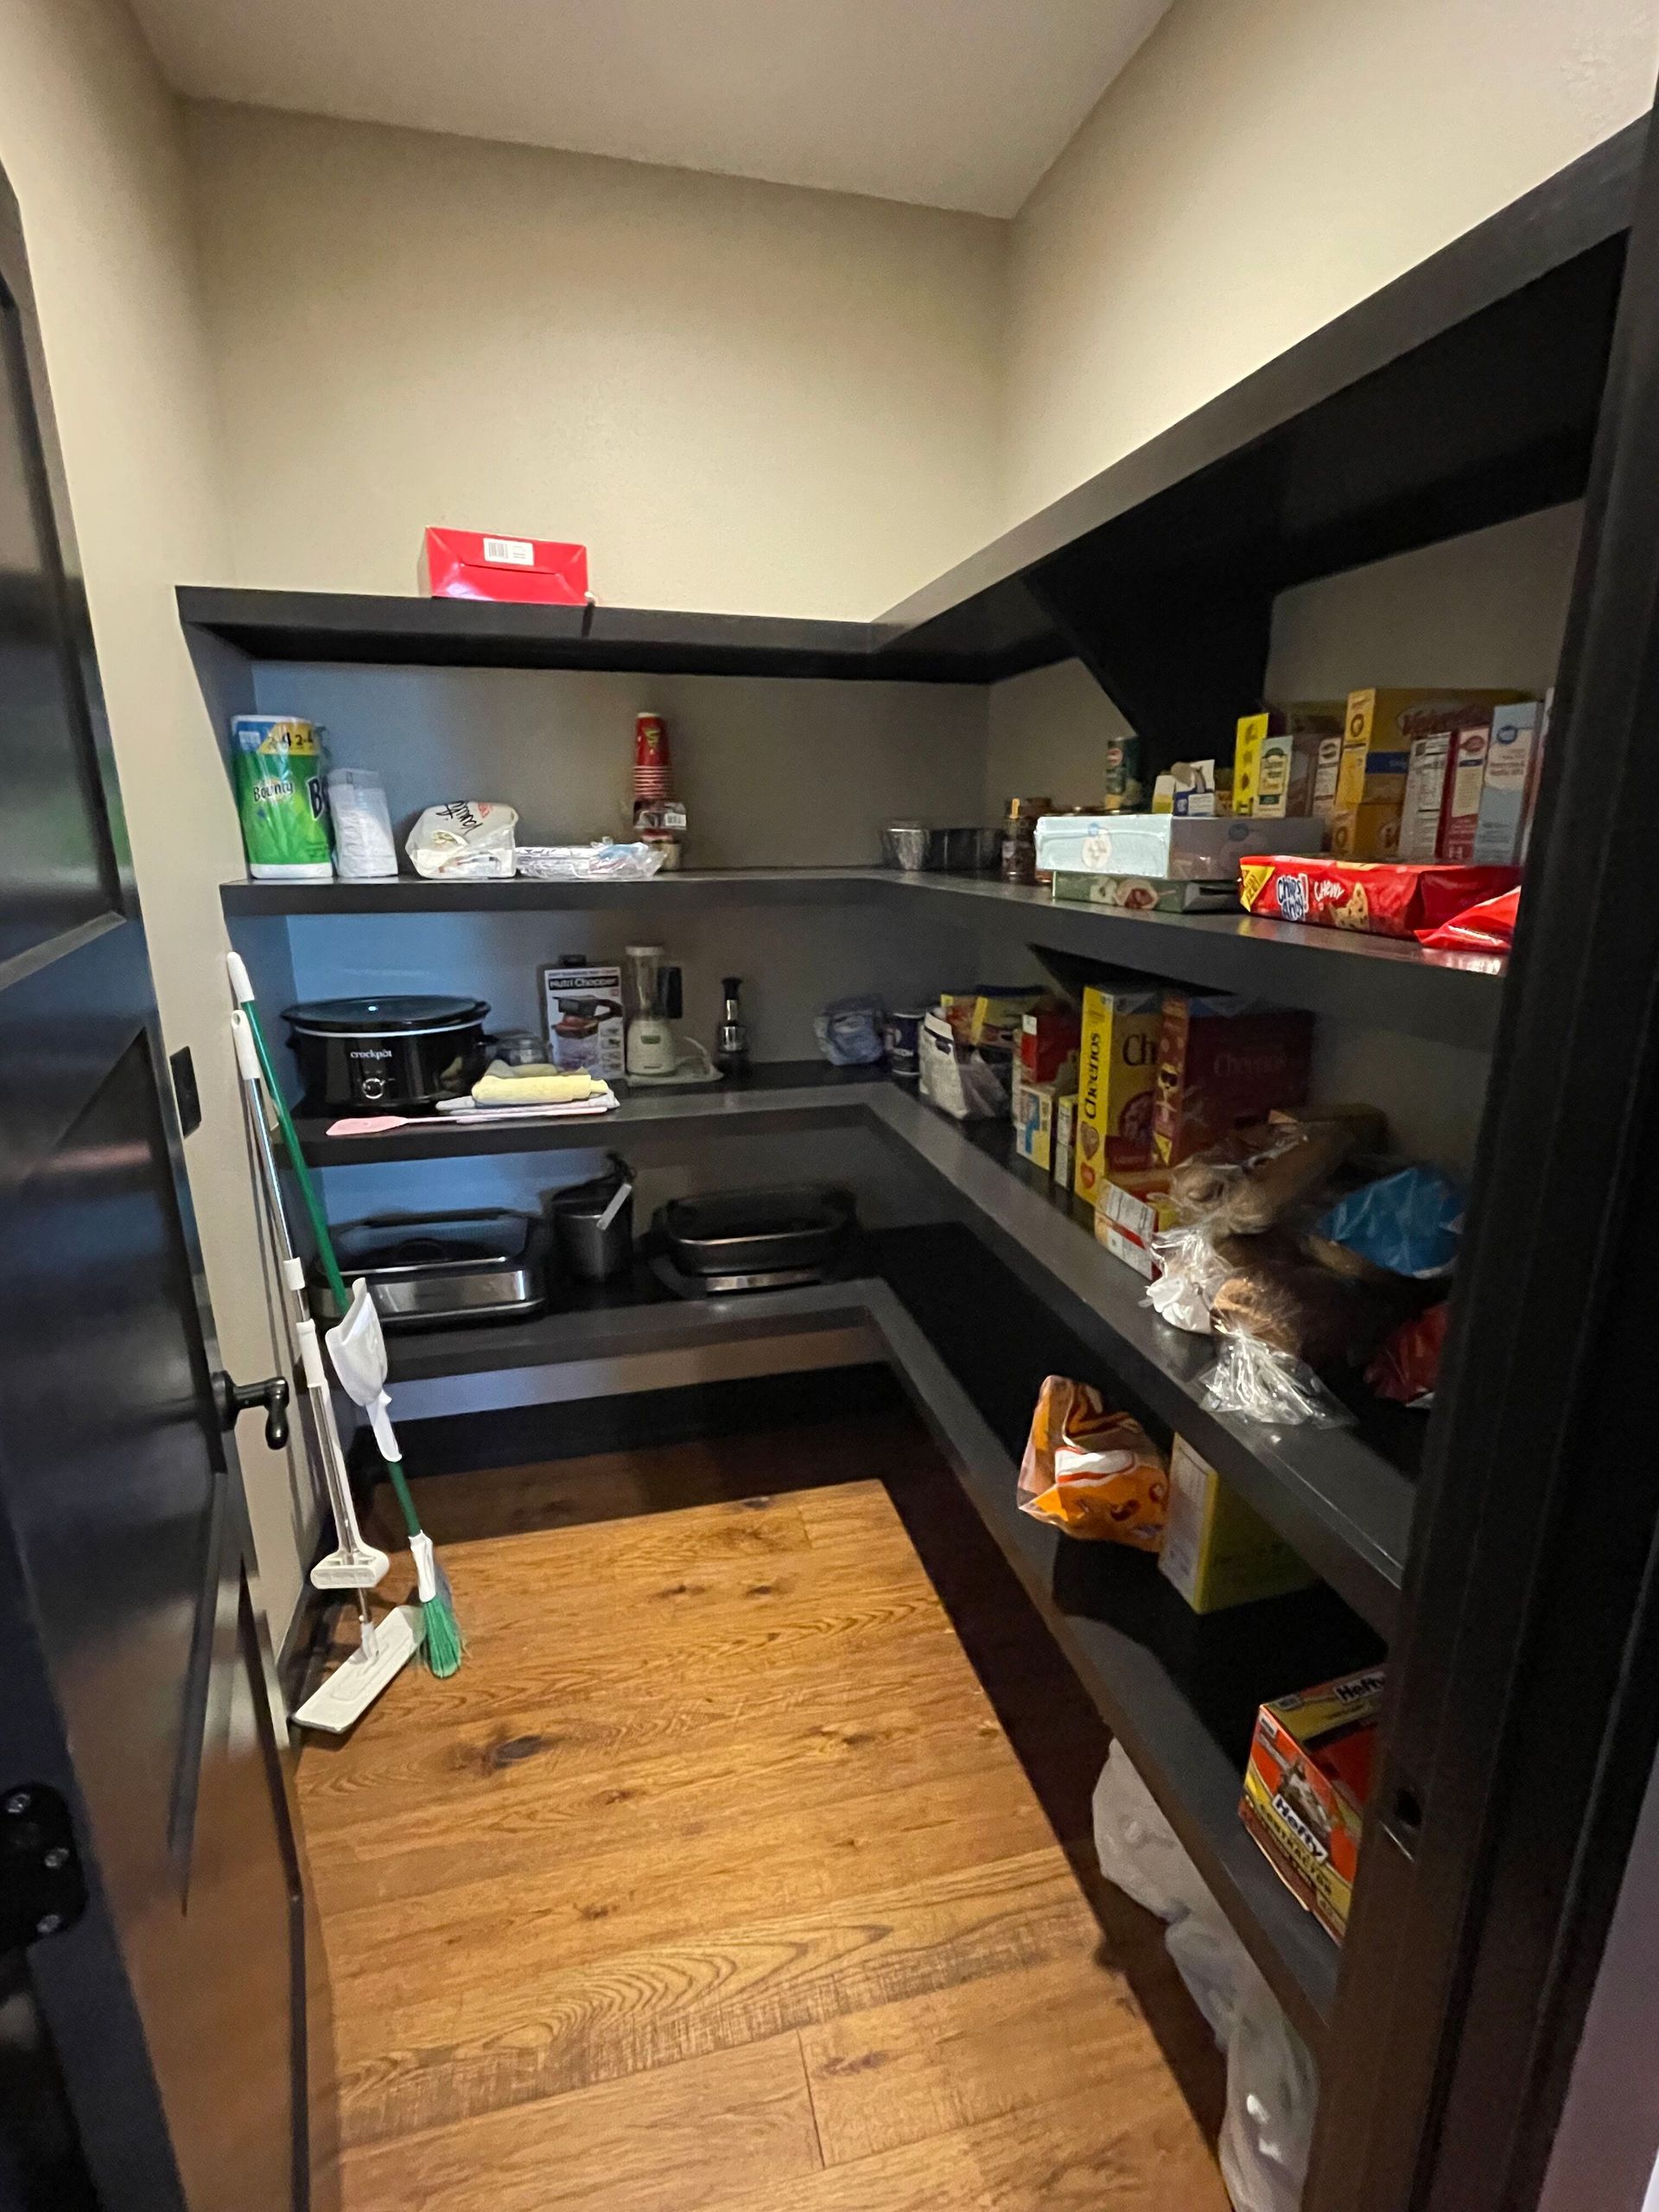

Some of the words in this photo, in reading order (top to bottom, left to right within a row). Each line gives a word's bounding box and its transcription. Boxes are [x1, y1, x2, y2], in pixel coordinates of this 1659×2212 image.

[253, 780, 294, 803] Bounty
[550, 978, 574, 989] Nutri
[575, 976, 617, 988] Chopper
[1275, 1796, 1324, 1859] Hefty
